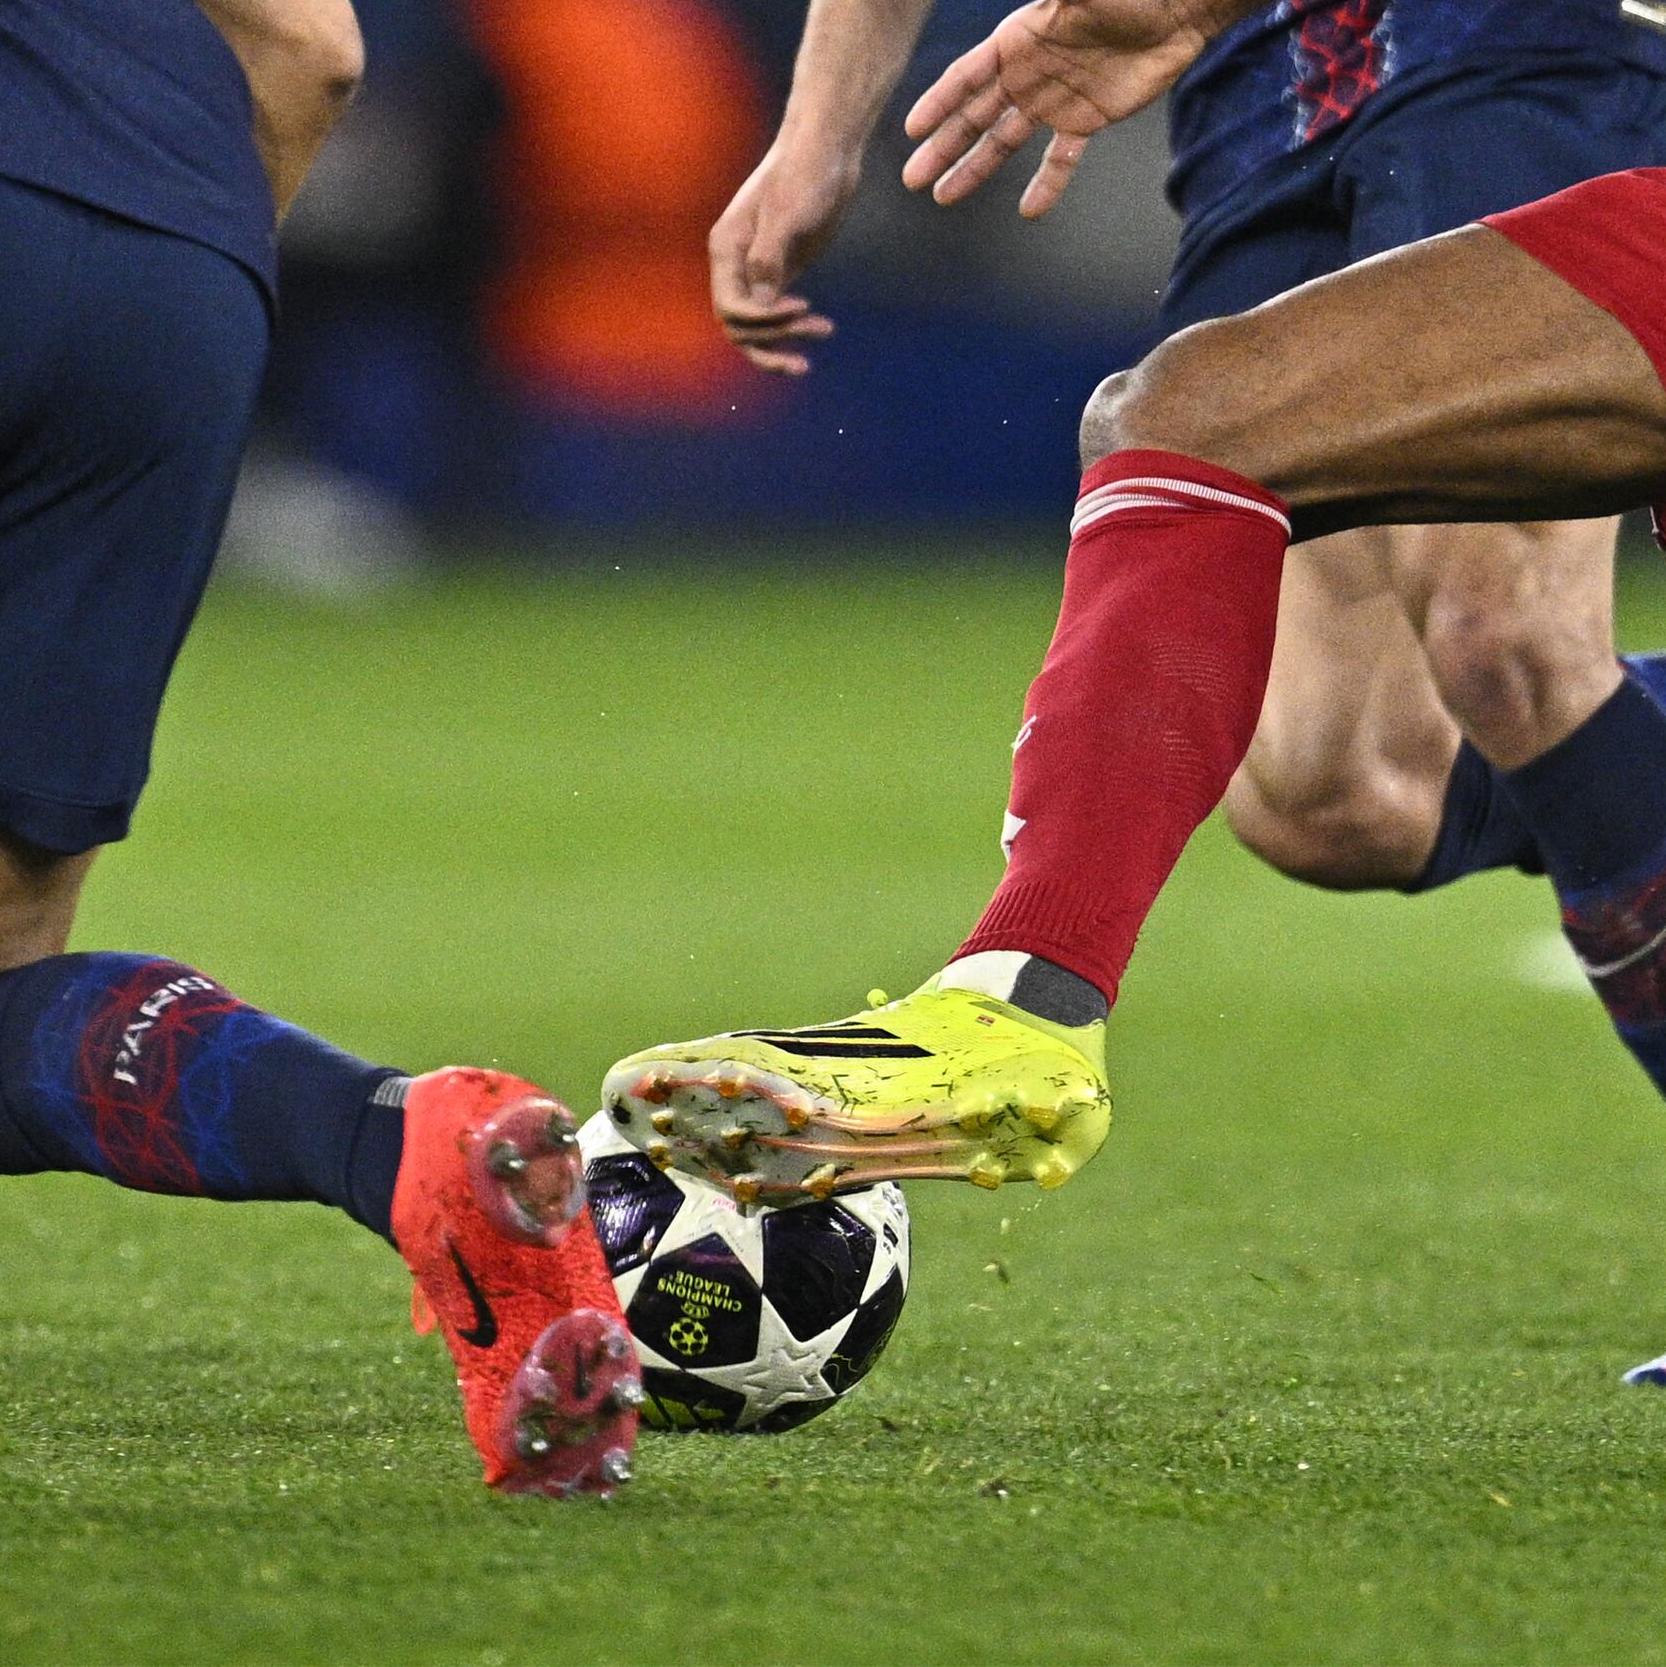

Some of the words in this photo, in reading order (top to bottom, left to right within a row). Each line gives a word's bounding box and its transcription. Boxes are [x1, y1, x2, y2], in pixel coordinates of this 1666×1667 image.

[113, 975, 216, 1085] PARIS
[657, 1277, 743, 1313] CHAMPIONS
[674, 1270, 730, 1297] LEAGUE
